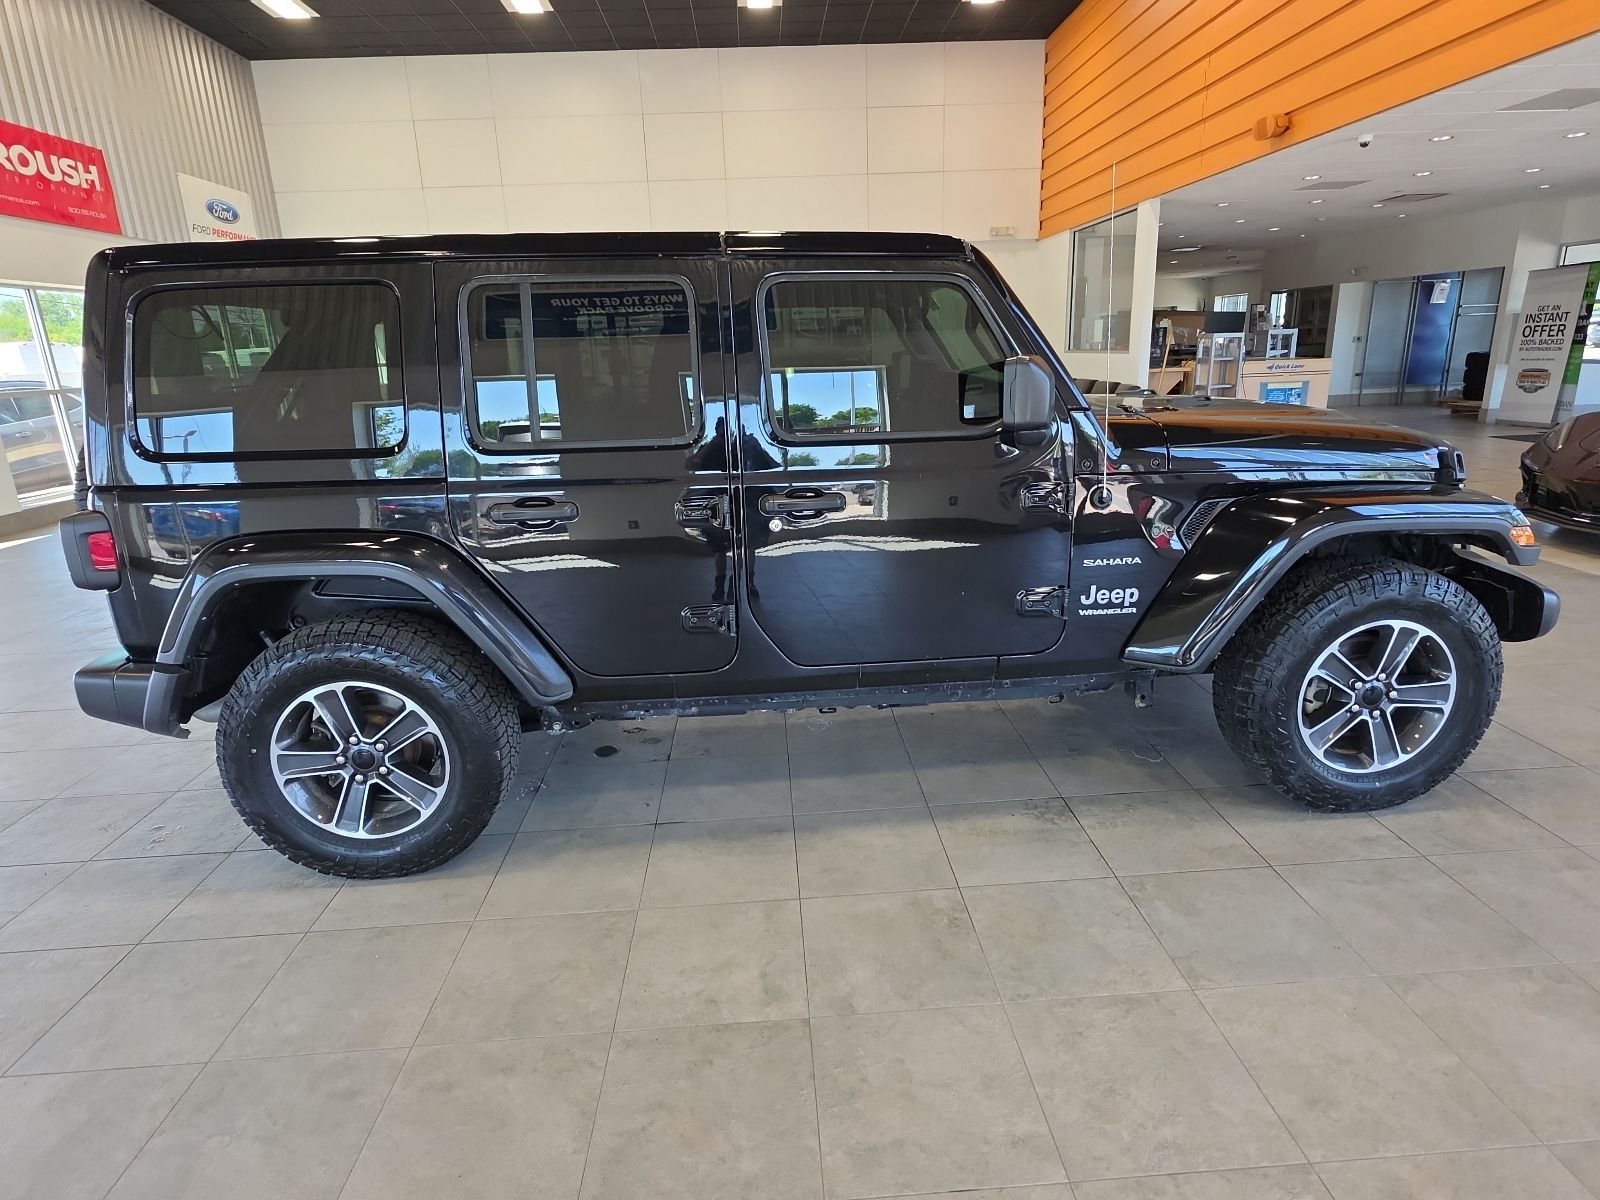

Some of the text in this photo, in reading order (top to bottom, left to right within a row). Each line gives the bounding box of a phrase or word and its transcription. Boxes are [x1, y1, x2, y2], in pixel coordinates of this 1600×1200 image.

[0, 142, 101, 192] ROUSH
[5, 173, 103, 203] ERFORMANCE
[212, 202, 234, 221] Ford
[192, 223, 211, 236] FORD
[1537, 303, 1562, 313] GET AN
[1524, 311, 1571, 324] INSTANT
[1522, 323, 1567, 339] OFFER
[1520, 338, 1565, 346] 100% BACKED
[1083, 556, 1142, 567] SAHARA
[1080, 584, 1139, 607] Jeep
[1078, 607, 1137, 616] WRANGLER
